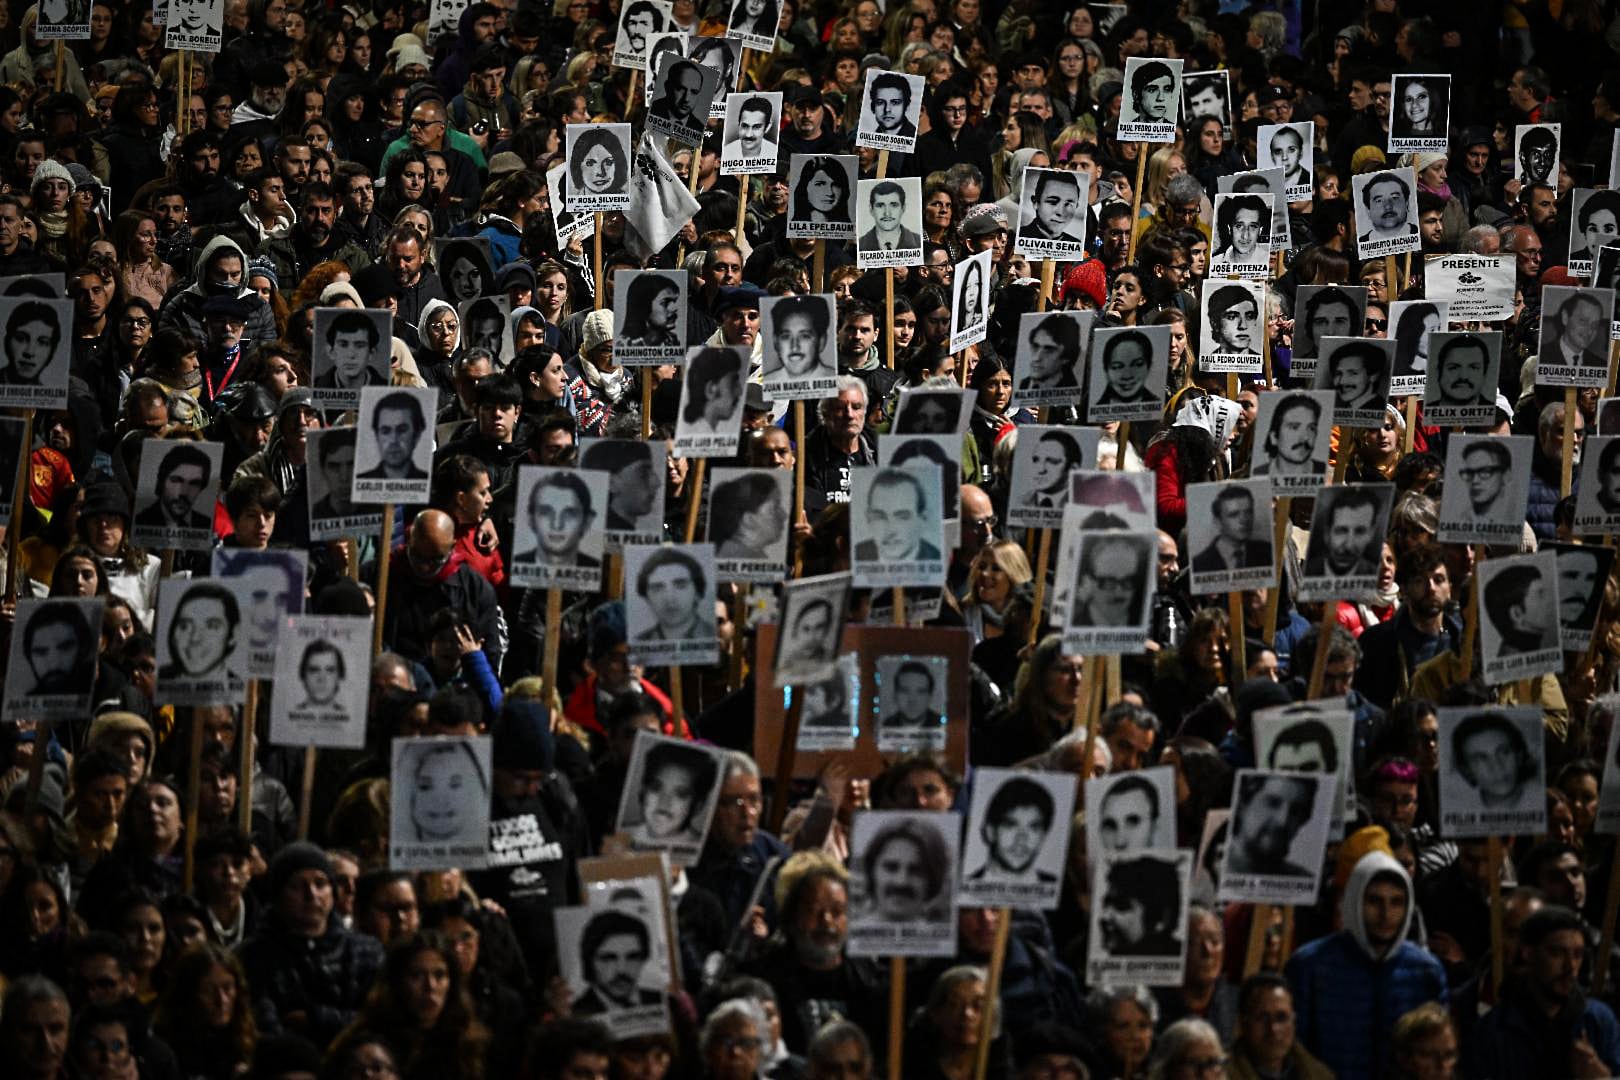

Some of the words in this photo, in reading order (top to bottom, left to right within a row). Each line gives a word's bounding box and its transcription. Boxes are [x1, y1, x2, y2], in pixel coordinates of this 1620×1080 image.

[189, 36, 221, 44] BORELLI
[648, 116, 672, 130] OSCAR
[673, 126, 702, 141] TASSINO
[1153, 126, 1176, 134] OLIVERA
[859, 132, 890, 143] GUILLERMO
[890, 135, 914, 145] SOBRINO
[1391, 139, 1421, 147] YOLANDA
[1423, 138, 1446, 147] CASCO
[722, 160, 743, 168] HUGO
[577, 197, 596, 205] ROSA
[598, 196, 630, 204] SILVEIRA
[558, 224, 577, 239] OSCAR
[577, 214, 595, 230] TASSI
[788, 222, 808, 231] LILA
[809, 222, 854, 232] EPELBAUM
[1018, 240, 1053, 250] OLIVAR
[1054, 243, 1081, 252] SENA
[1360, 241, 1391, 252] HUMBERTO
[1391, 235, 1419, 248] MACHADO
[860, 252, 885, 260] RICARDO
[886, 250, 921, 259] ALTAMIRANO
[1232, 264, 1268, 272] POTENZA
[1441, 259, 1500, 269] PRESENTE
[1569, 261, 1592, 271] MAR
[615, 348, 661, 356] WASHINGTON
[664, 348, 684, 356] CRAM
[1538, 367, 1576, 377] EDUARDO
[1578, 369, 1607, 378] BLEIER
[783, 383, 810, 391] MANUEL
[313, 391, 357, 400] EDUARDO
[1460, 407, 1495, 416] ORTIZ
[1284, 477, 1324, 486] TEJERA
[1575, 517, 1601, 525] LUIS
[1440, 522, 1473, 532] CARLOS
